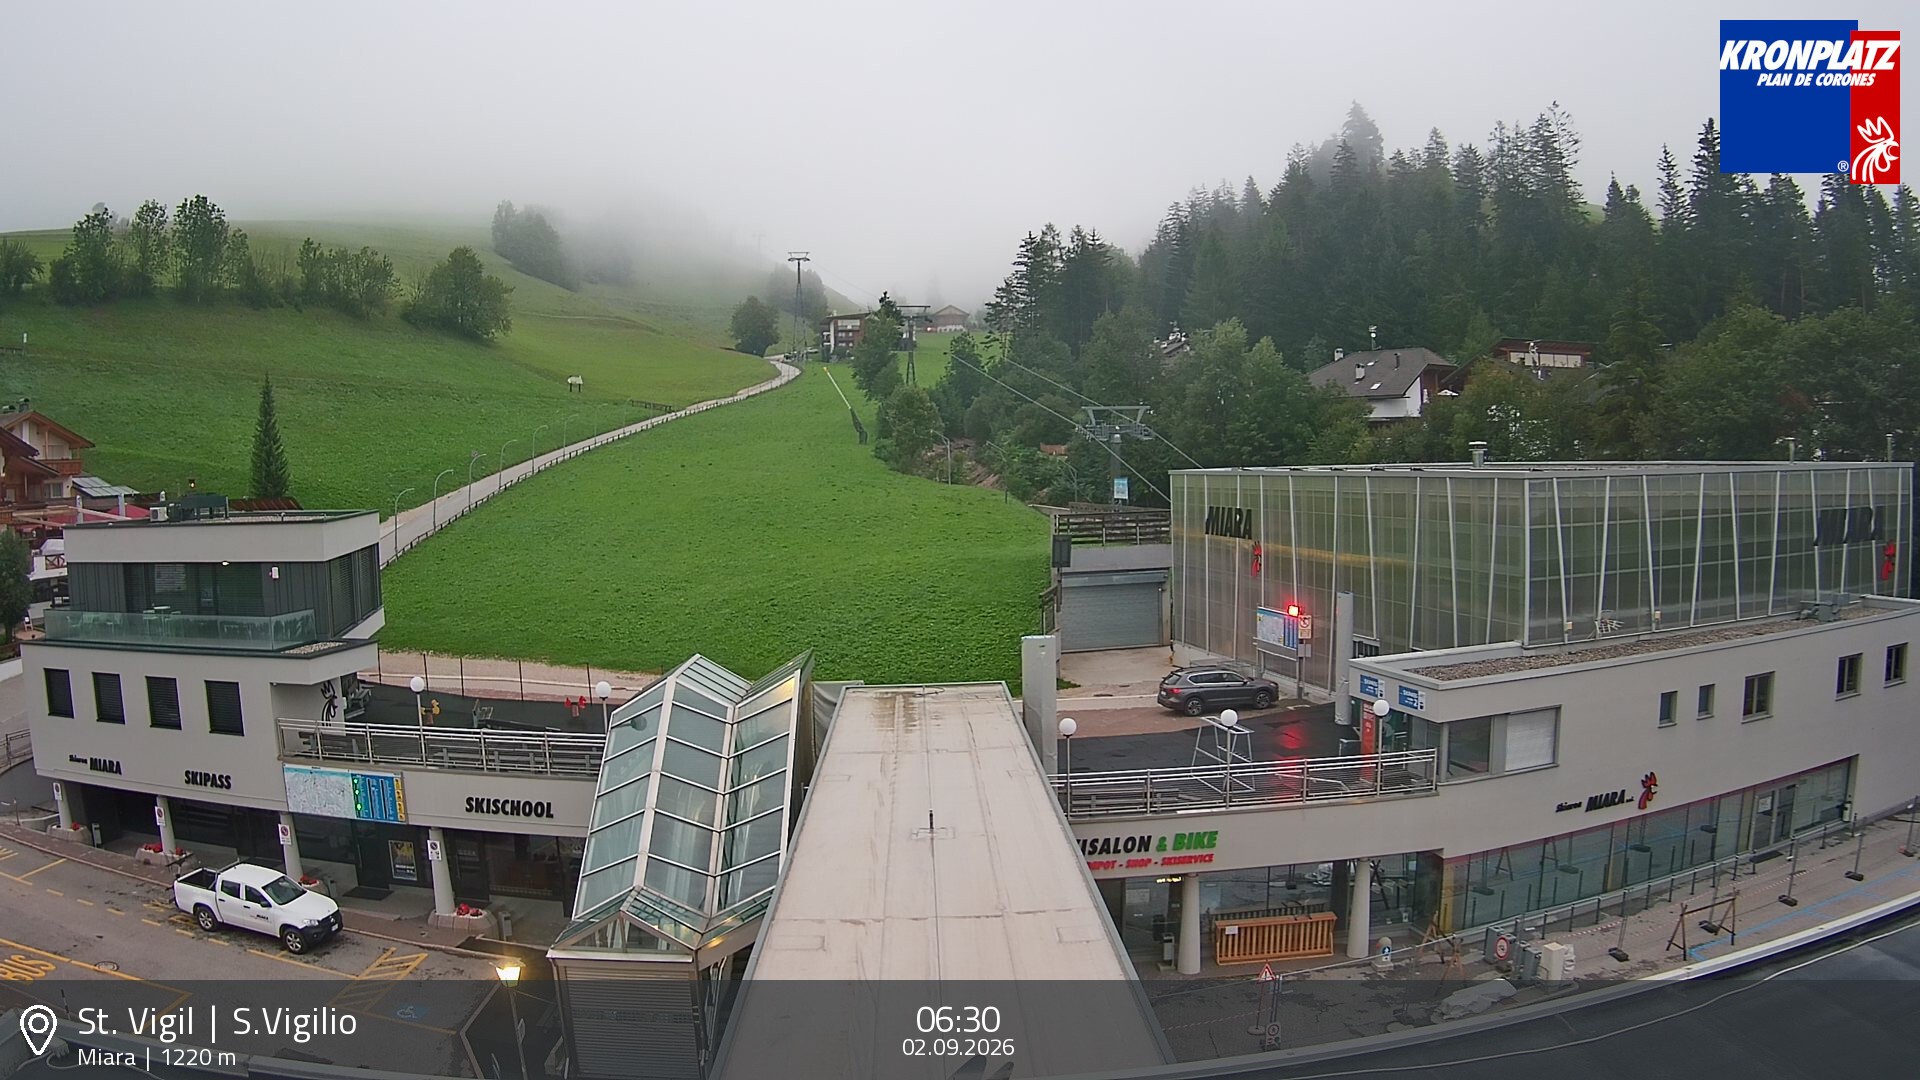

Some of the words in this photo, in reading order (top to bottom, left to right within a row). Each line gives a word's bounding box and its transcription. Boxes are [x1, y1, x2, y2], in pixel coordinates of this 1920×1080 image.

[1205, 506, 1253, 539] MIARA
[90, 757, 122, 775] MIARA
[185, 770, 231, 790] SKIPASS
[465, 797, 554, 818] SKISCHOOL
[1585, 789, 1626, 812] MIARA
[1156, 836, 1167, 852] &
[1172, 831, 1218, 851] BIKE
